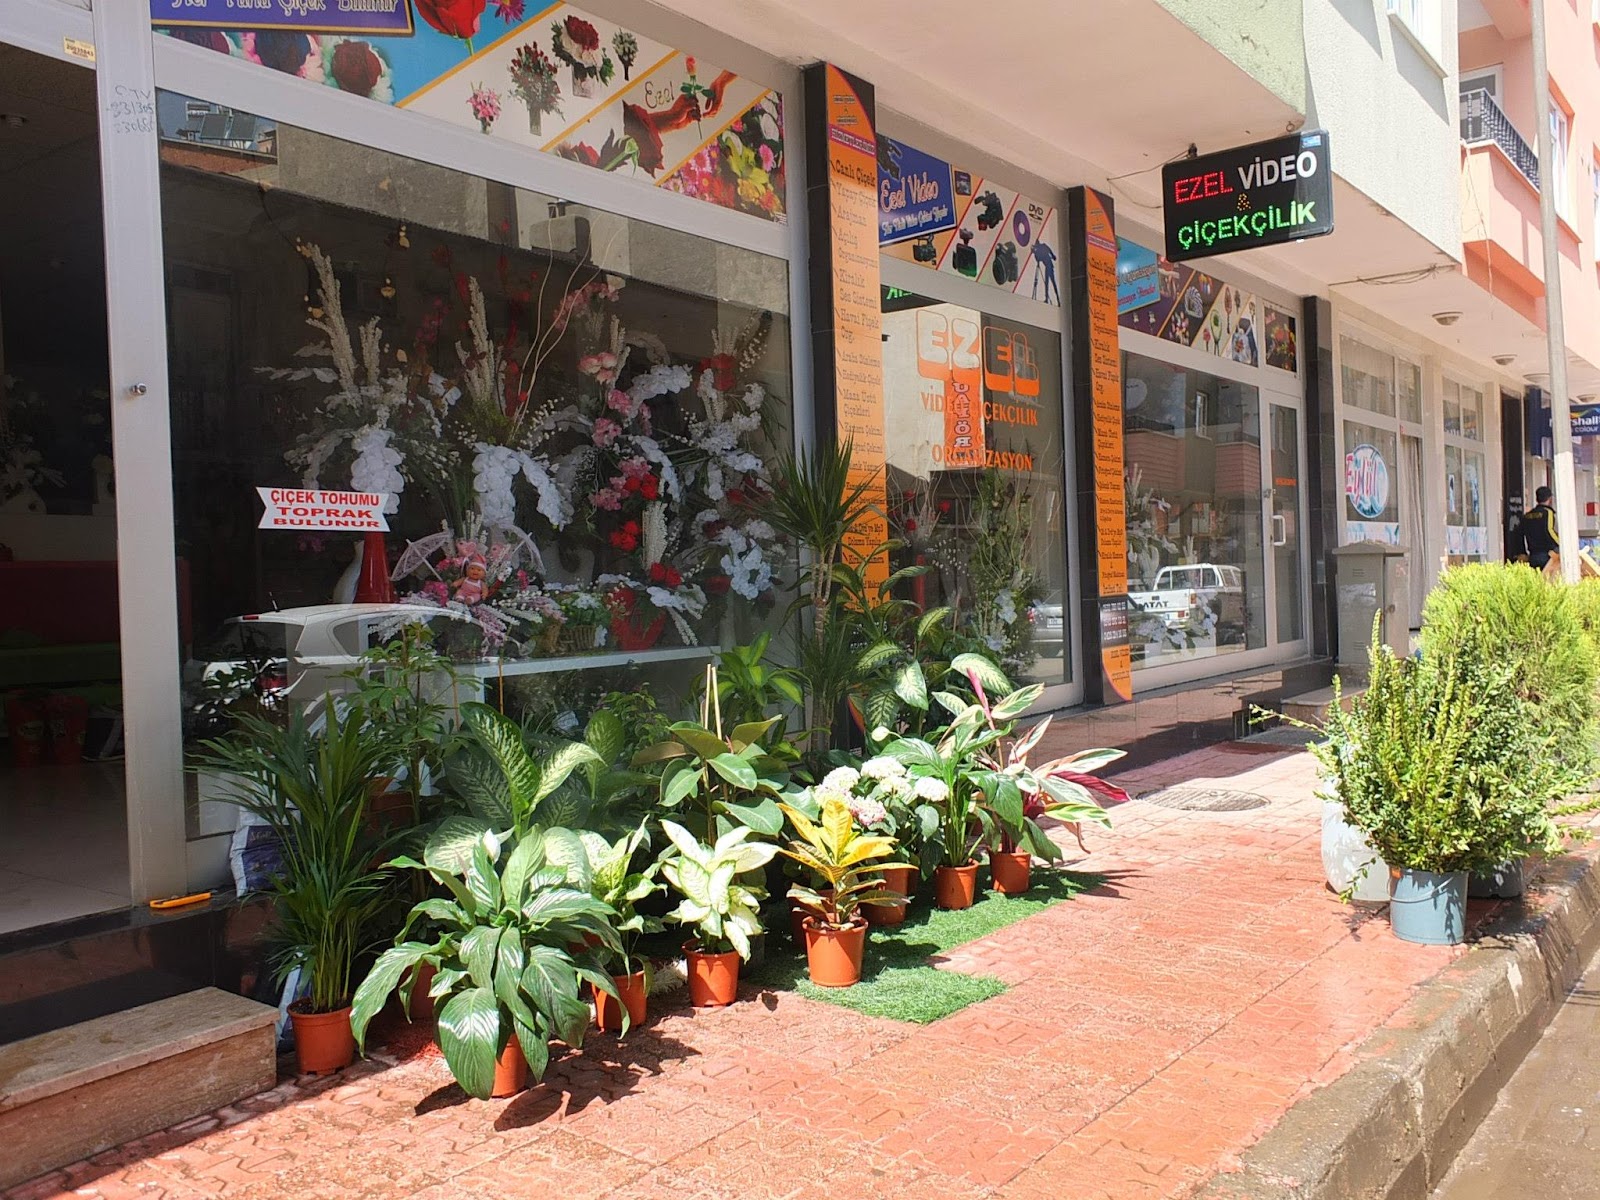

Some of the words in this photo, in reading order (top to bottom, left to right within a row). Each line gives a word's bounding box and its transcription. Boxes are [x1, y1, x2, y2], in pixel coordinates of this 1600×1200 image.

[1174, 171, 1234, 204] EZEL
[1237, 151, 1318, 190] VİDEO
[907, 171, 939, 205] Video
[1028, 203, 1044, 216] DVD
[1236, 193, 1251, 212] &
[1177, 200, 1317, 250] ÇİÇEKÇİLİK
[916, 309, 1040, 396] EZEL
[270, 488, 315, 506] ÇİÇEK
[320, 492, 380, 506] TOHUMU
[276, 506, 373, 519] TOPRAK
[273, 518, 380, 528] BULUNUR
